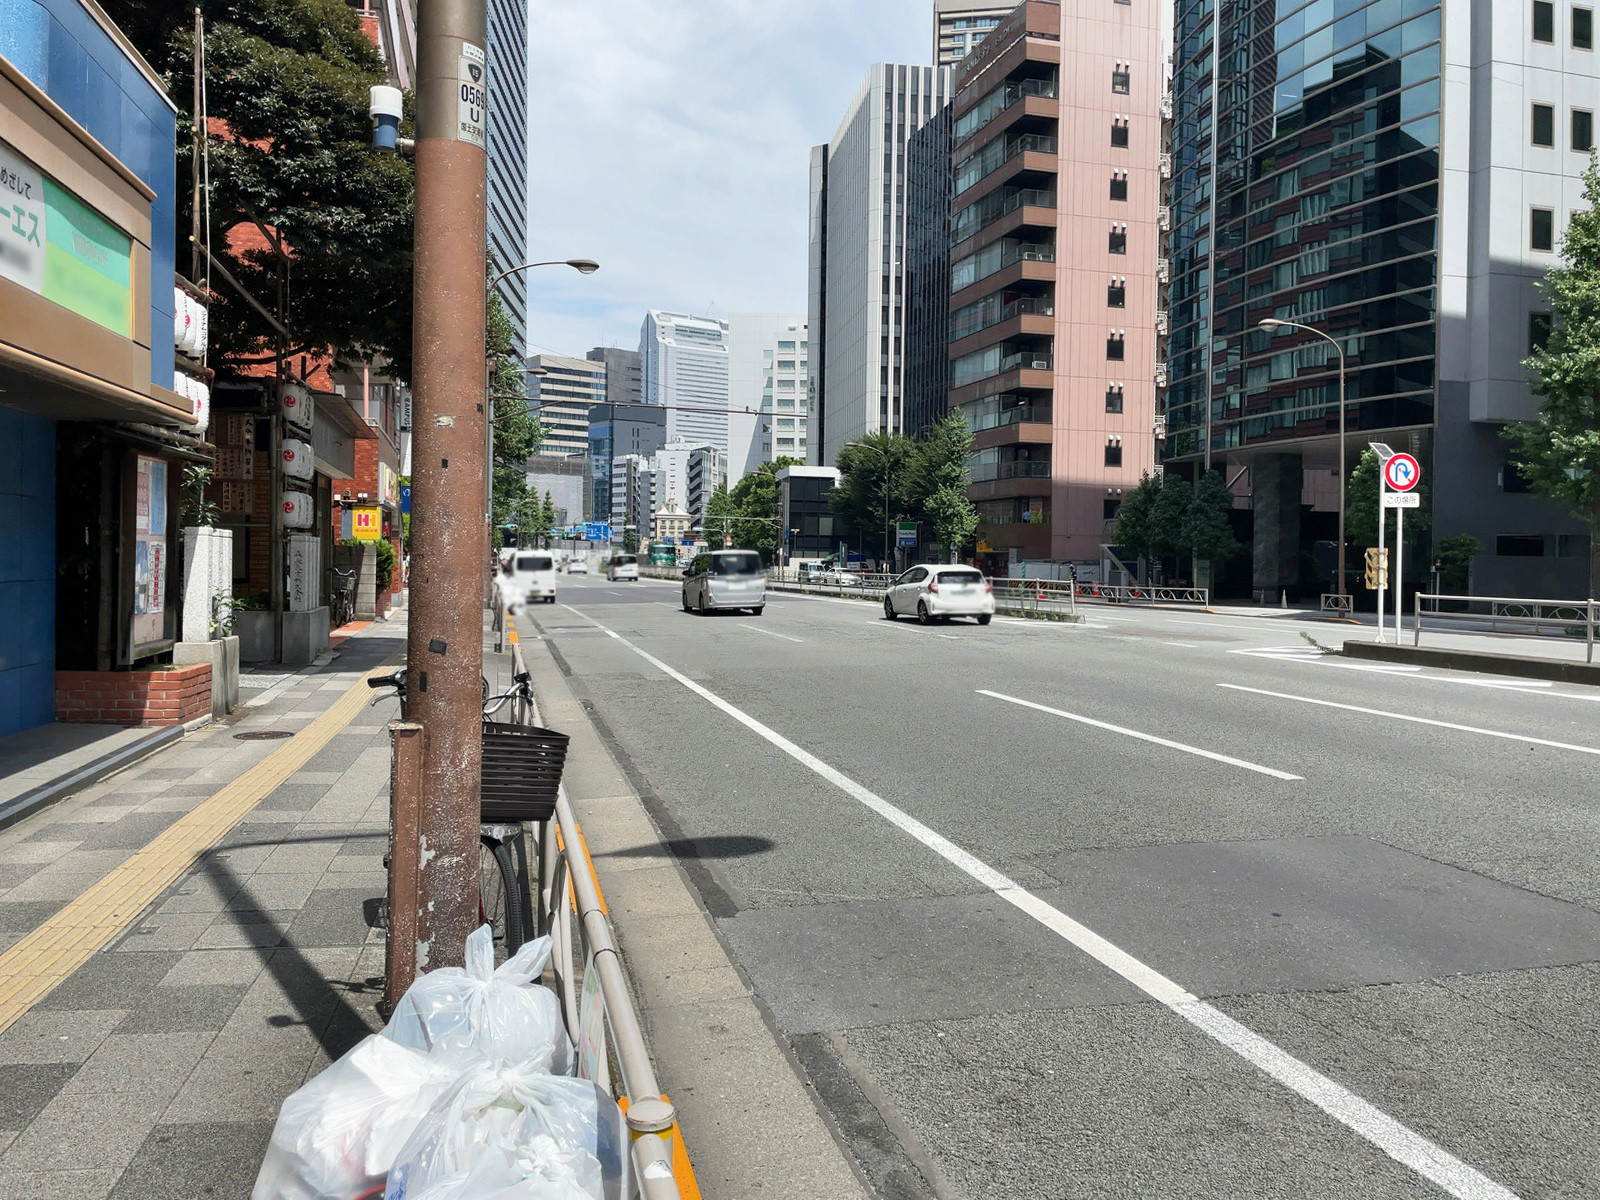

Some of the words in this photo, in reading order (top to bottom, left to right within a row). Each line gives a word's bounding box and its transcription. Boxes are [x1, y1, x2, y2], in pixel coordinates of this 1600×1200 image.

[471, 68, 480, 78] 15
[461, 84, 485, 110] 0569
[470, 107, 480, 123] U
[0, 167, 32, 201] めざして
[1387, 496, 1417, 505] この場所
